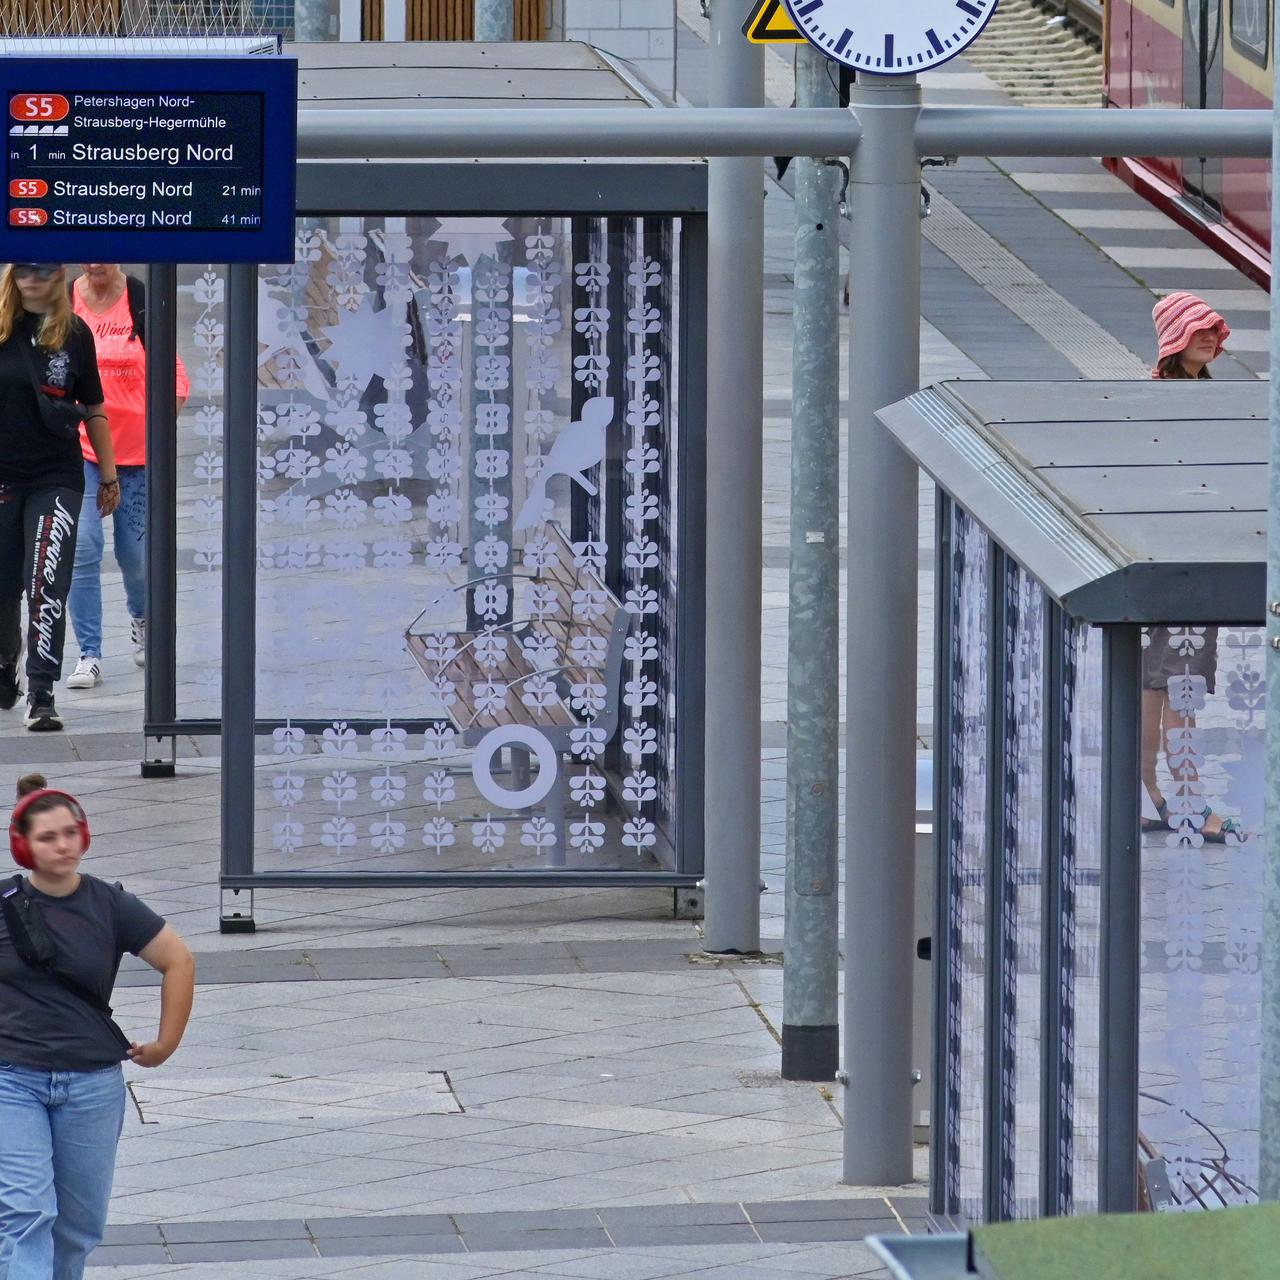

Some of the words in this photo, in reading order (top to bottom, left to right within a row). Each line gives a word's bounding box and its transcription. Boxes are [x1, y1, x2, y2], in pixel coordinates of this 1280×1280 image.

[25, 97, 54, 117] S5
[74, 95, 155, 109] Petershagen
[159, 95, 195, 108] Nord-
[74, 116, 226, 131] Strausberg-Hegermühle
[10, 150, 20, 160] in
[29, 144, 37, 161] 1
[48, 150, 66, 160] min
[72, 144, 180, 165] Strausberg
[186, 144, 234, 161] Nord
[18, 182, 38, 195] S5
[53, 181, 146, 200] Strausberg
[152, 181, 193, 196] Nord
[222, 185, 237, 196] 21
[240, 185, 261, 196] min
[53, 209, 146, 228] Strausberg
[151, 209, 192, 226] Nord
[221, 214, 236, 225] 41
[240, 214, 261, 225] min
[43, 496, 74, 585] Marine
[32, 586, 62, 665] Royal
